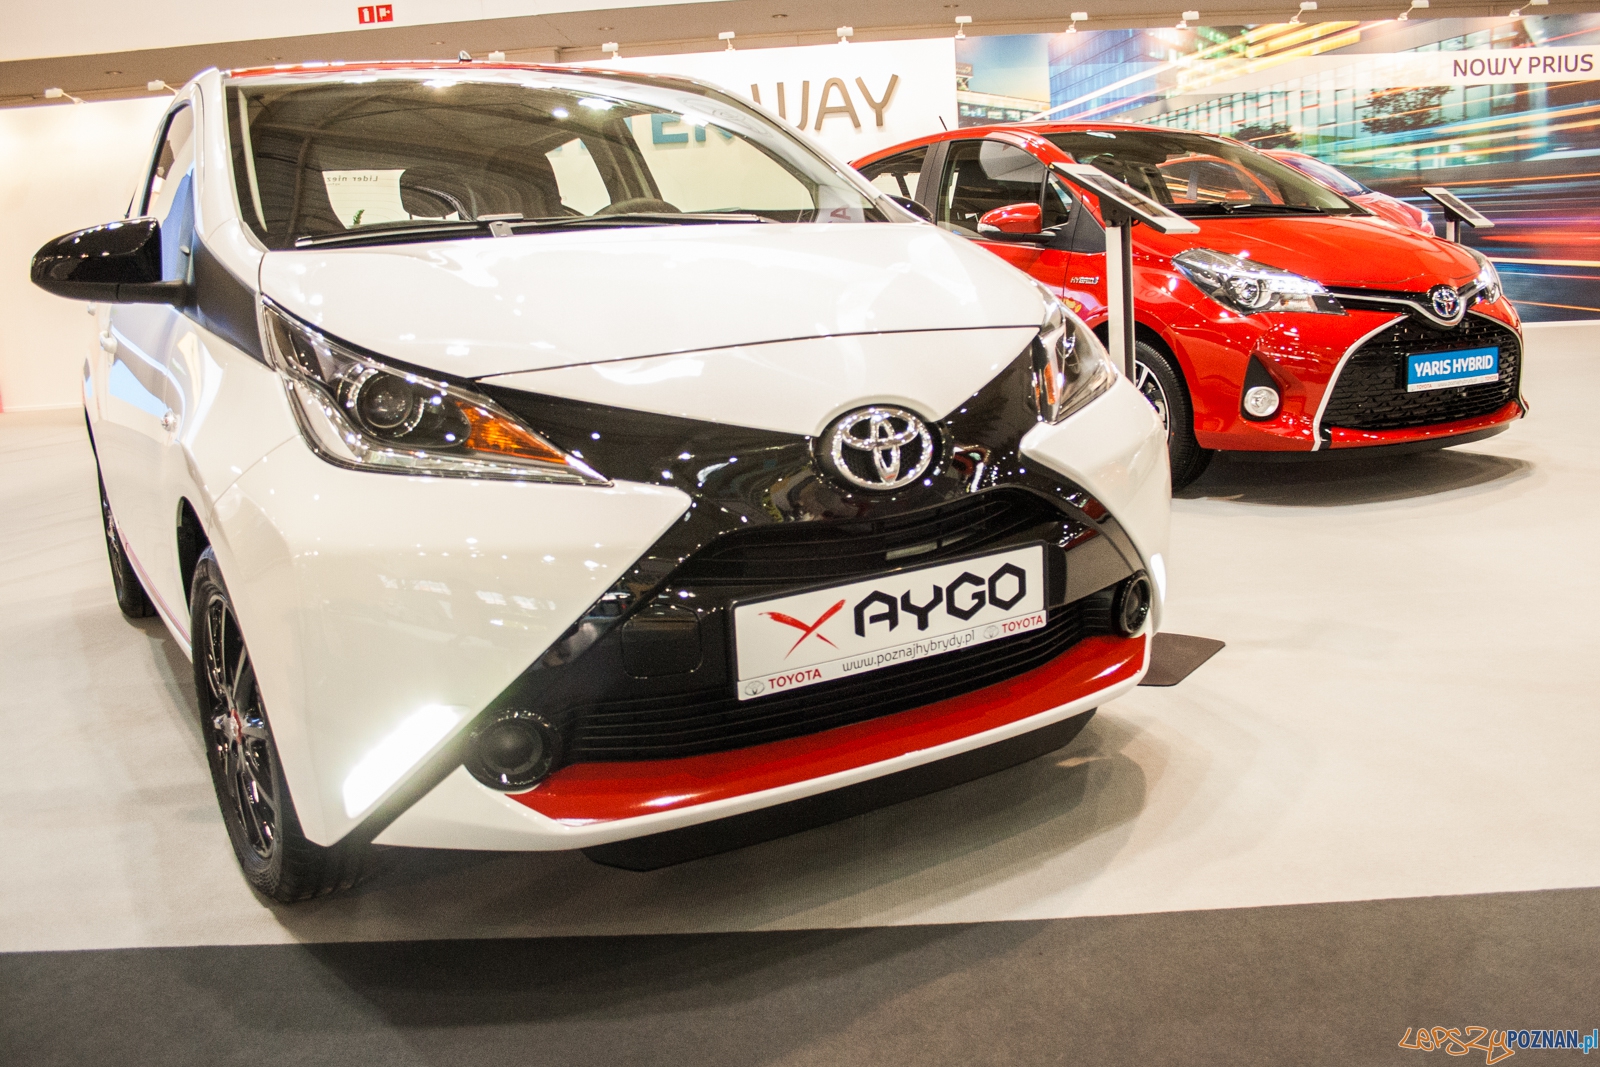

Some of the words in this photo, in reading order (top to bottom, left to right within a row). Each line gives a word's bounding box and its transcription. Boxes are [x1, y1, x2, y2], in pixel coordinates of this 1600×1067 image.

[1453, 57, 1523, 77] NOWY
[1528, 54, 1594, 75] PRIUS
[1414, 359, 1451, 378] YARIS
[1452, 354, 1494, 374] HYBRID
[853, 562, 1027, 638] AYGO
[768, 668, 822, 690] TOYOTA
[842, 630, 976, 673] www.poznajhybrydy.pl
[1001, 614, 1044, 635] TOYOTA
